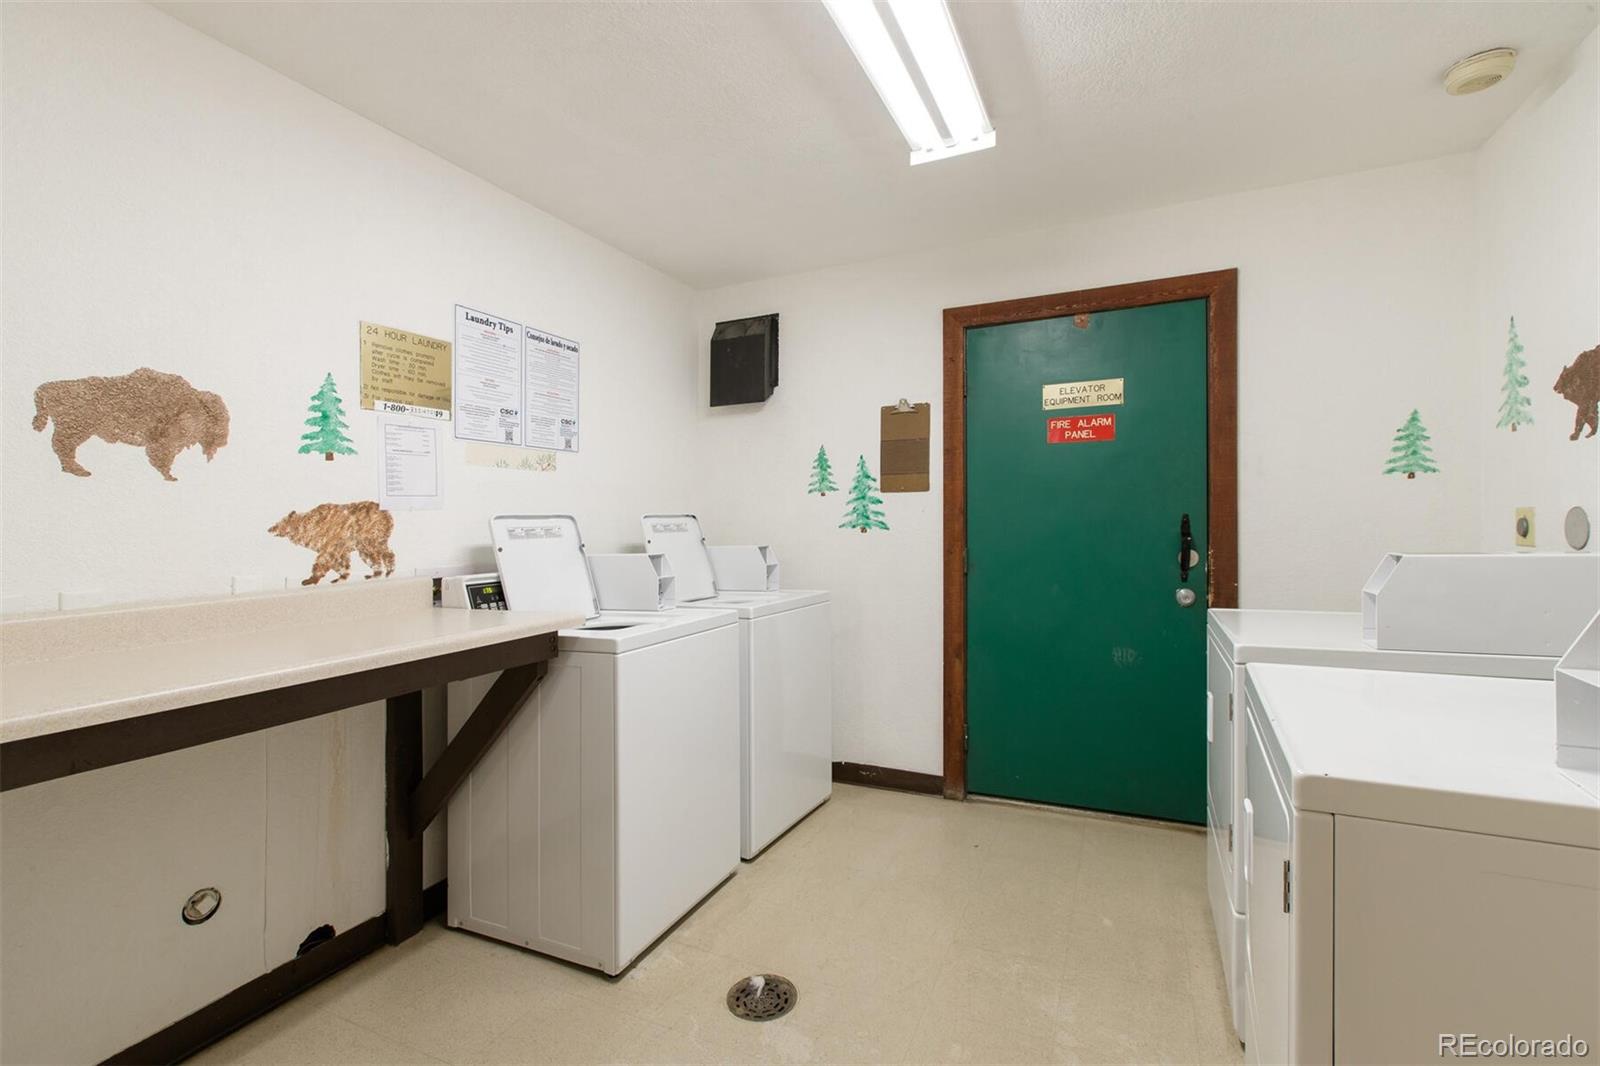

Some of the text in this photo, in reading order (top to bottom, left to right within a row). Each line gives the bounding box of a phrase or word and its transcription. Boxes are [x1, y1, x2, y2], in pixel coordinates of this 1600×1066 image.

[466, 311, 514, 334] Laundry Tips
[366, 326, 448, 352] 24 HOUR LAUNDRY
[372, 368, 390, 377] Clothes
[1059, 384, 1106, 396] ELEVATOR
[1044, 393, 1122, 406] EQUIPMENT ROOM
[500, 408, 514, 416] CSC
[1050, 416, 1112, 430] FIRE ALARM
[1064, 430, 1096, 440] PANEL
